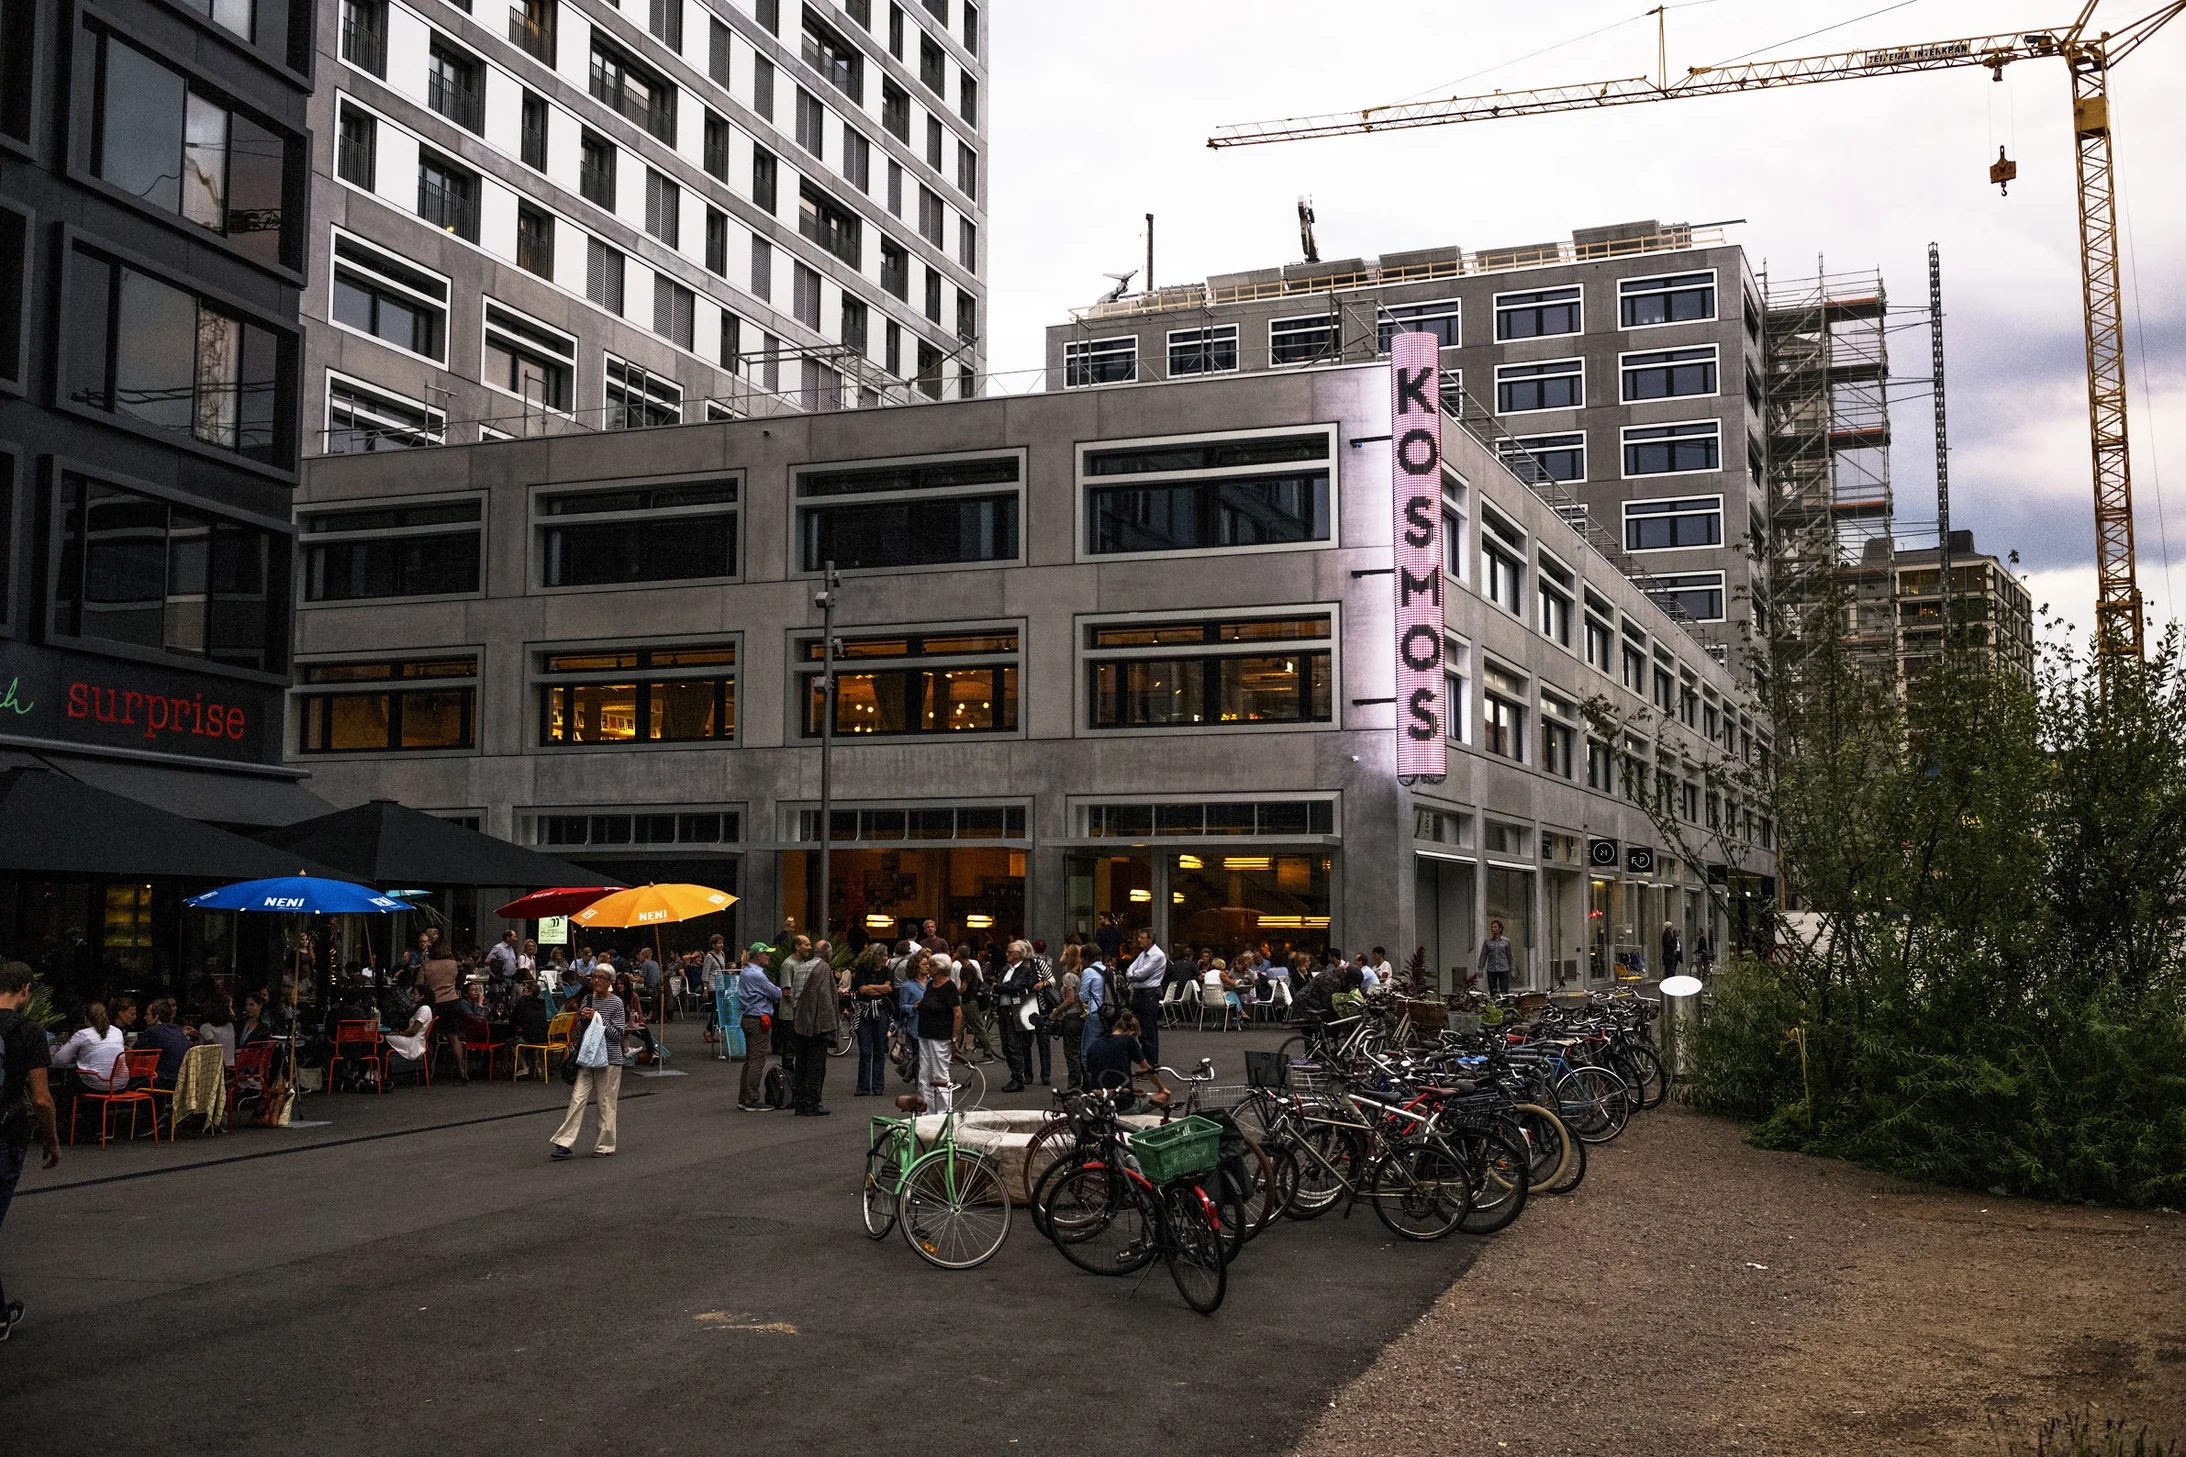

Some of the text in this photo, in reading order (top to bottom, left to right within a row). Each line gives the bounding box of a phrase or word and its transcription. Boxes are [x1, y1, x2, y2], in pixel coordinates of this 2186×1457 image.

[1396, 366, 1441, 742] KOSMOS
[0, 676, 34, 714] h
[66, 681, 246, 741] surprise
[263, 896, 305, 908] NENI
[638, 909, 668, 922] NENI
